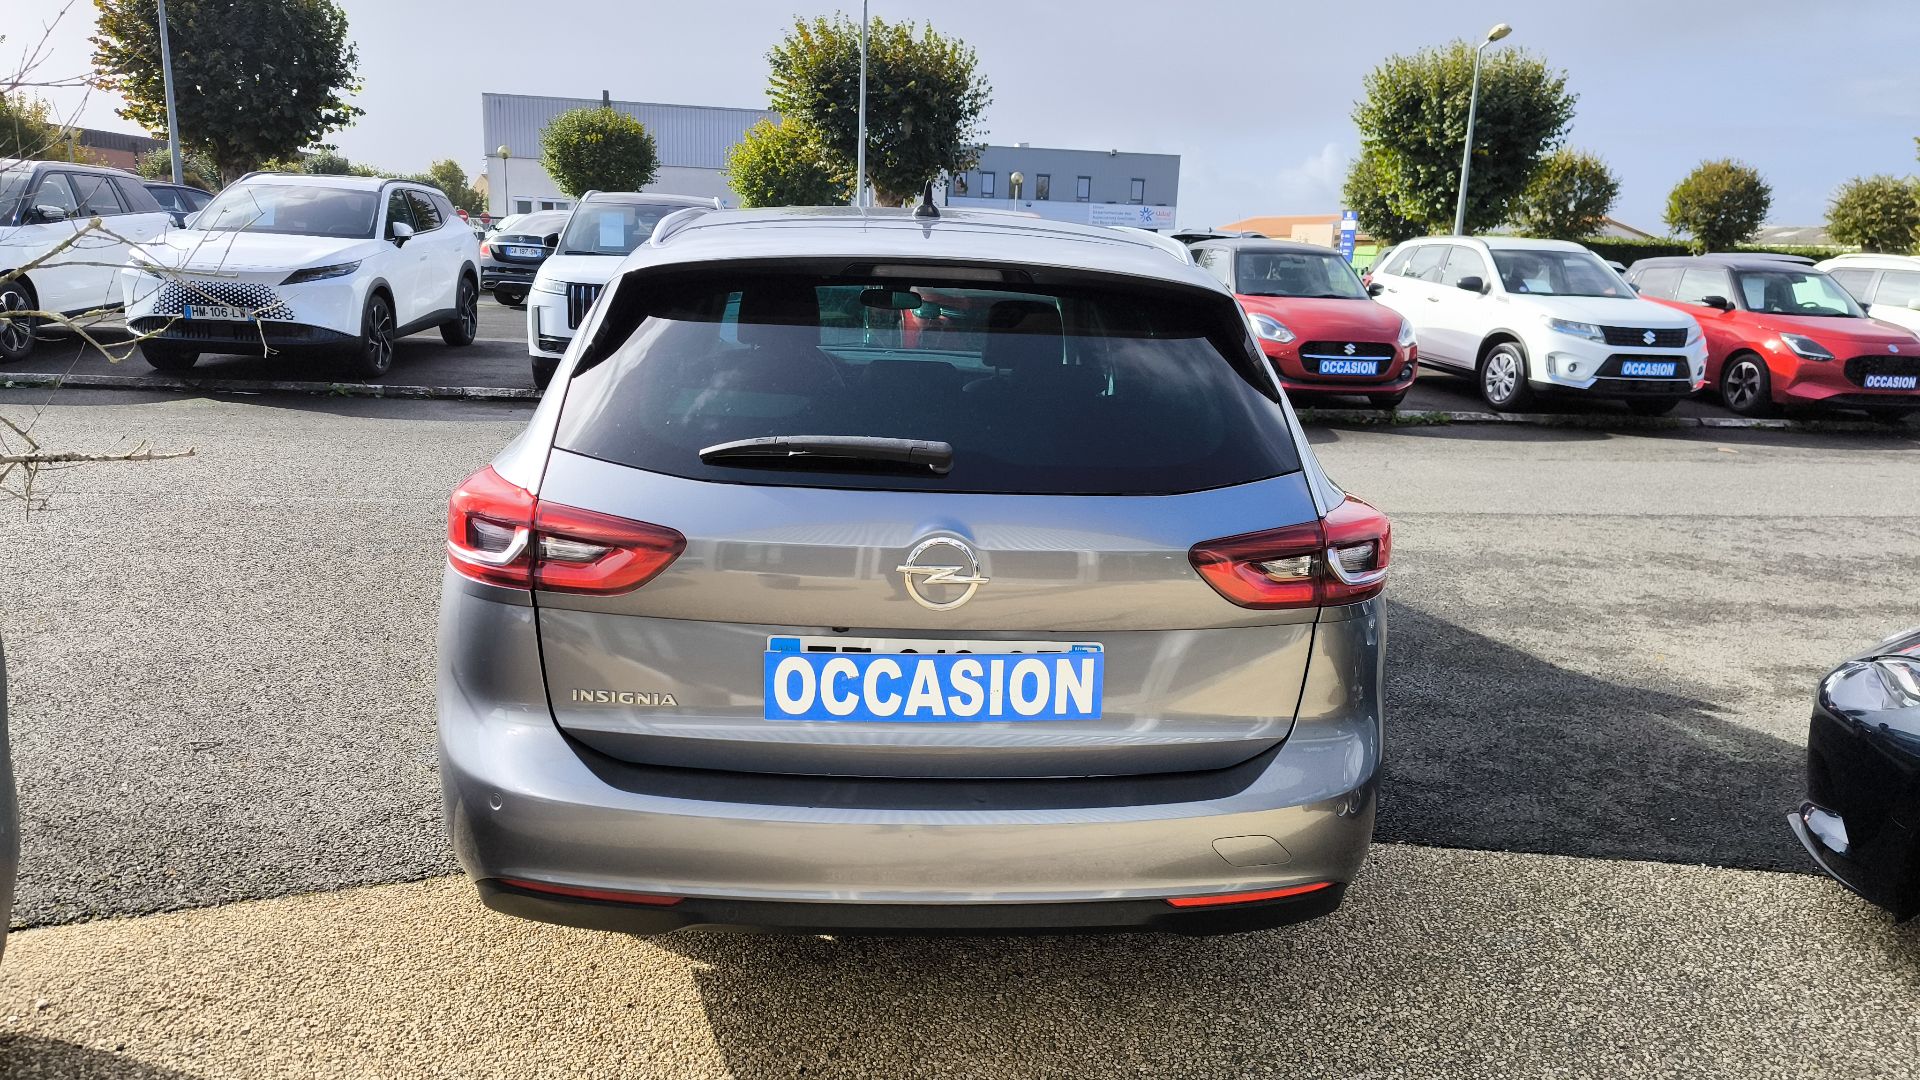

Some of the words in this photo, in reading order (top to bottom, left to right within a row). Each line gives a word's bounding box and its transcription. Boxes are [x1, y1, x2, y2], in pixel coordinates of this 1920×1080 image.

[1321, 360, 1377, 374] OCCASION
[1623, 362, 1675, 376] OCCASION
[1866, 375, 1917, 389] OCCASION
[773, 656, 1095, 717] OCCASION
[572, 689, 679, 706] INSIGNIA
